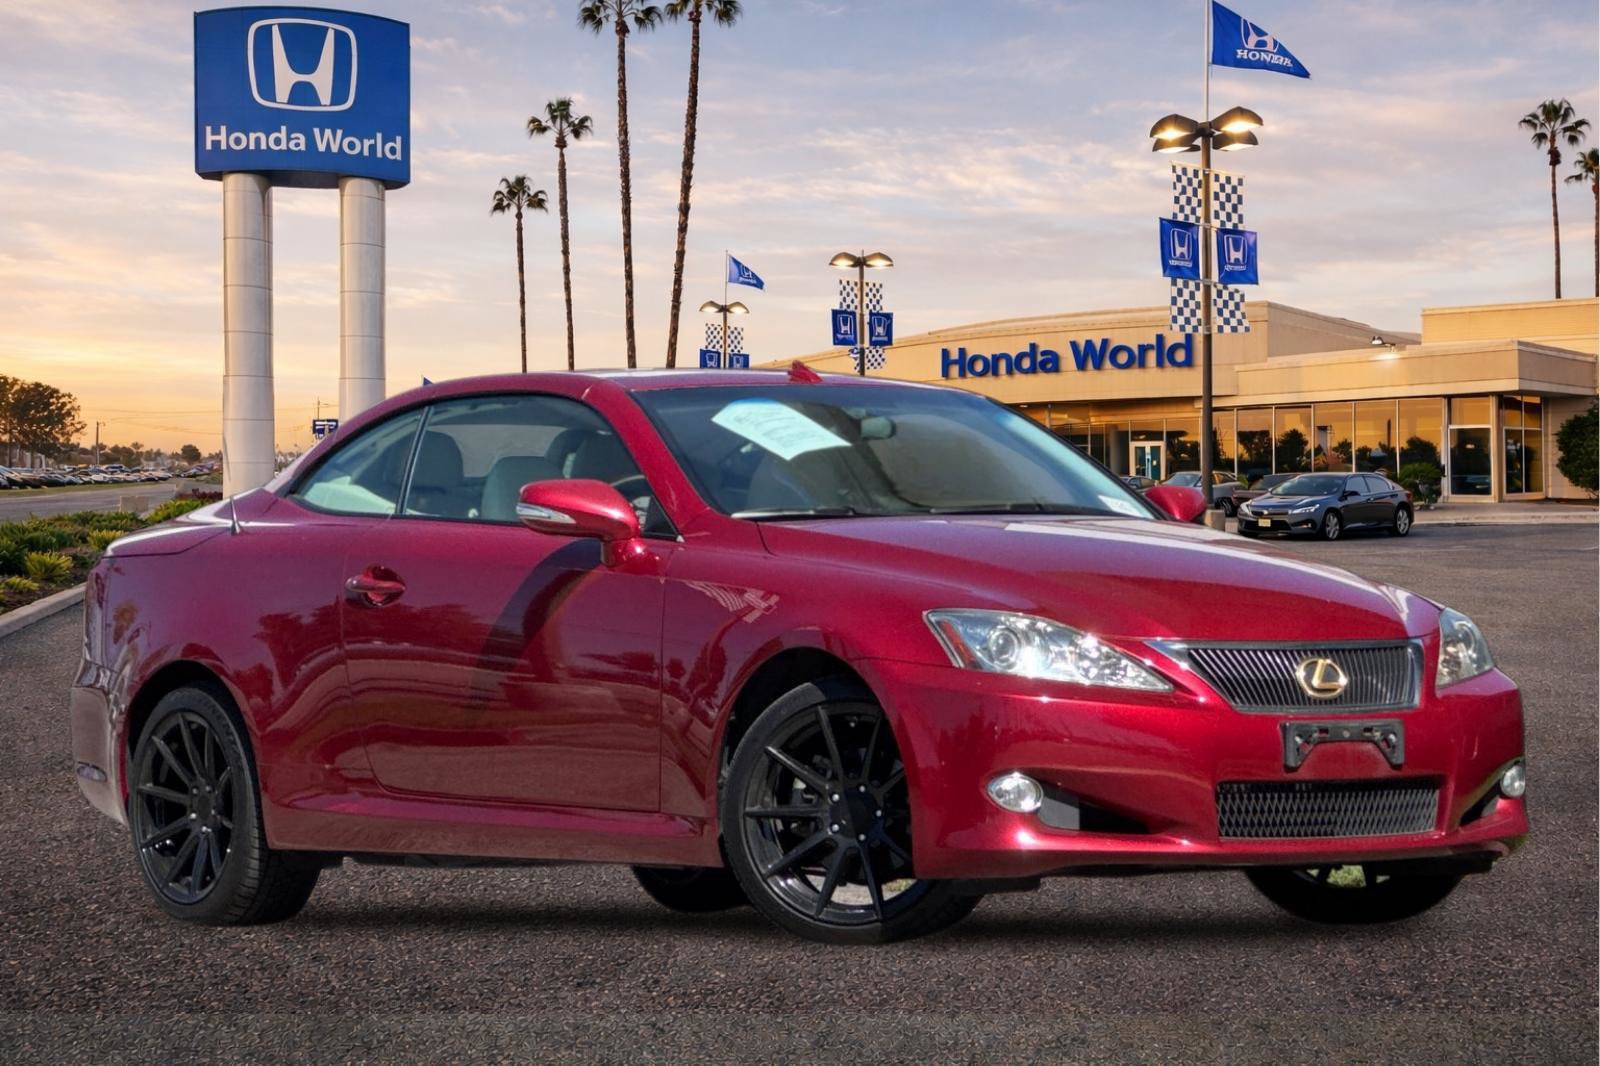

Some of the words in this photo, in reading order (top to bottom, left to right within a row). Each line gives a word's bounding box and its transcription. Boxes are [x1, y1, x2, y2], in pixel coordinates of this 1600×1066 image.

[205, 125, 306, 151] Honda
[312, 127, 403, 161] World
[941, 342, 1060, 379] Honda
[1069, 333, 1194, 371] World
